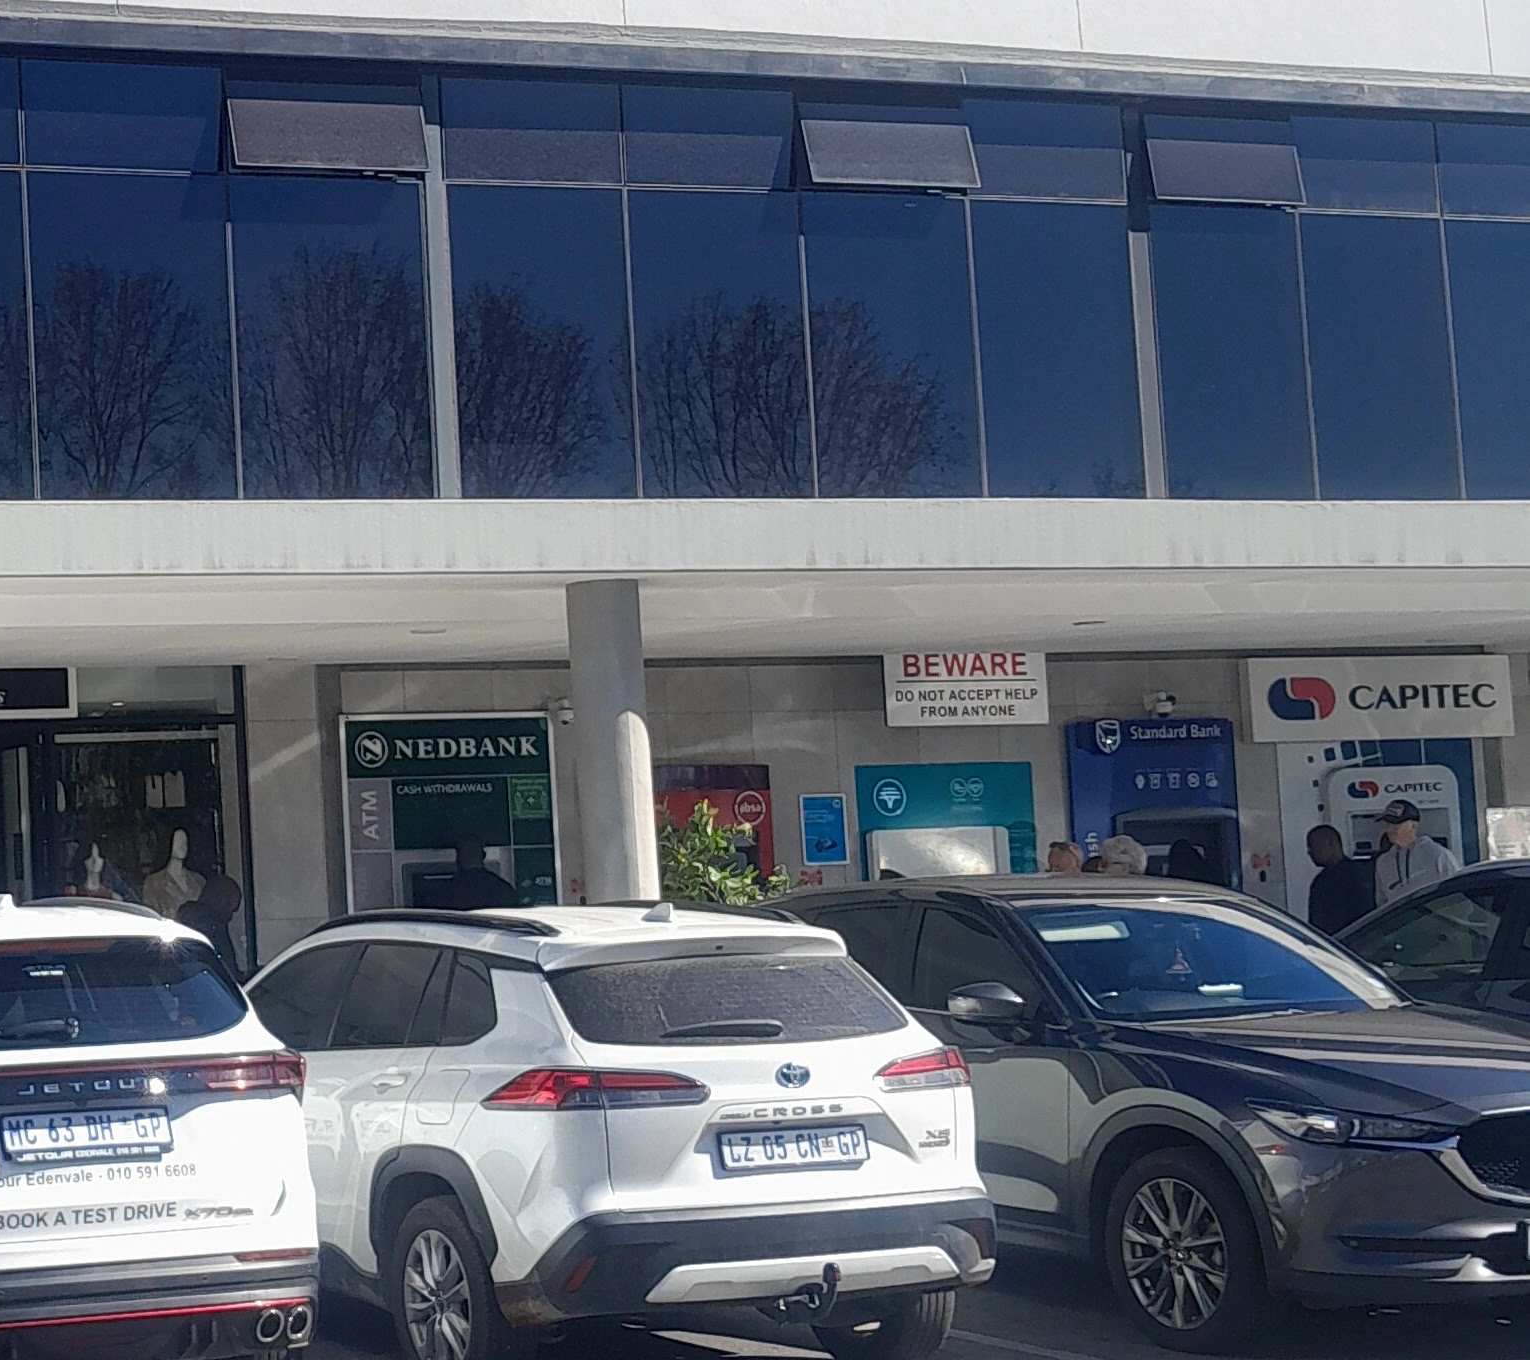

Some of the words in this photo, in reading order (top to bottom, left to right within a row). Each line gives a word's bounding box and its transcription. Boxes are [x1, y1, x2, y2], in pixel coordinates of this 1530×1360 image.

[902, 652, 1028, 678] BEWARE
[895, 690, 914, 702] DO
[919, 689, 944, 702] NOT
[948, 689, 1001, 701] ACCEPT
[1004, 688, 1038, 701] HELP
[1348, 683, 1497, 710] CAPITEC
[920, 706, 958, 718] FROM
[961, 705, 1016, 717] ANYONE
[1129, 723, 1187, 740] Standard
[1190, 723, 1222, 738] Bank
[393, 735, 540, 760] NEDBANK
[396, 784, 421, 795] CASH
[1383, 781, 1443, 793] CAPITEC
[361, 790, 379, 841] ATM
[18, 1077, 165, 1096] JETOU
[753, 1103, 843, 1119] CROSS
[7, 1118, 37, 1147] MC
[48, 1116, 75, 1143] 63
[133, 1111, 161, 1139] GP
[16, 1150, 74, 1163] JETOUR
[727, 1136, 755, 1163] LZ
[794, 1132, 821, 1159] CN
[837, 1130, 861, 1156] GP
[26, 1170, 93, 1186] Edenvale
[106, 1167, 132, 1181] 010
[137, 1165, 160, 1178] 591
[165, 1163, 197, 1177] 6608
[53, 1211, 67, 1227] A
[71, 1206, 118, 1225] TEST
[123, 1201, 178, 1222] DRIVE
